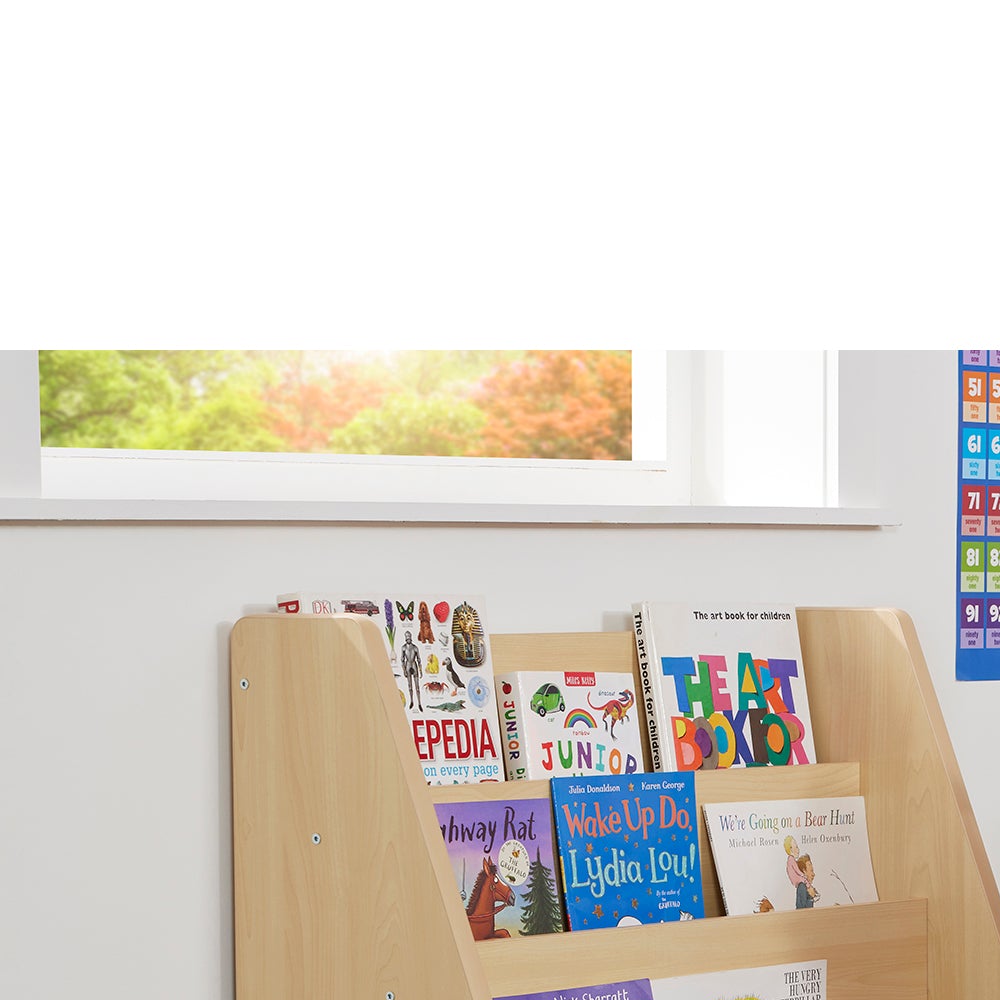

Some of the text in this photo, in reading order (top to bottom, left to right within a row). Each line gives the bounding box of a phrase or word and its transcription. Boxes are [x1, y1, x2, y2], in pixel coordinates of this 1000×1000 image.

[969, 378, 981, 396] 51
[968, 435, 980, 452] 61
[968, 492, 980, 509] 71
[967, 549, 979, 566] 81
[693, 610, 791, 621] The art book for children
[966, 605, 978, 622] 91
[634, 612, 661, 770] The art book for children
[661, 652, 799, 719] THE ART
[503, 701, 520, 761] JUNIOR
[670, 708, 810, 770] BOOK FOR
[541, 740, 638, 775] JUNIOR
[424, 766, 438, 777] on
[440, 765, 470, 778] every
[473, 764, 499, 777] page
[568, 783, 621, 795] Julia Donaldson
[641, 780, 685, 792] Karen George
[503, 806, 537, 841] Rat
[562, 801, 622, 839] Wake
[621, 797, 655, 840] Up
[719, 814, 747, 832] We're
[749, 812, 780, 834] Going
[781, 817, 793, 829] on
[795, 818, 801, 828] a
[805, 810, 828, 828] Bear
[829, 809, 856, 826] Hunt
[728, 836, 779, 849] Michael Rosen
[801, 832, 852, 845] Helen Oxenbury
[568, 847, 644, 898] Lydia
[648, 843, 696, 884] Lou!
[784, 968, 823, 984] THE VERY
[789, 981, 822, 997] HUNGRY
